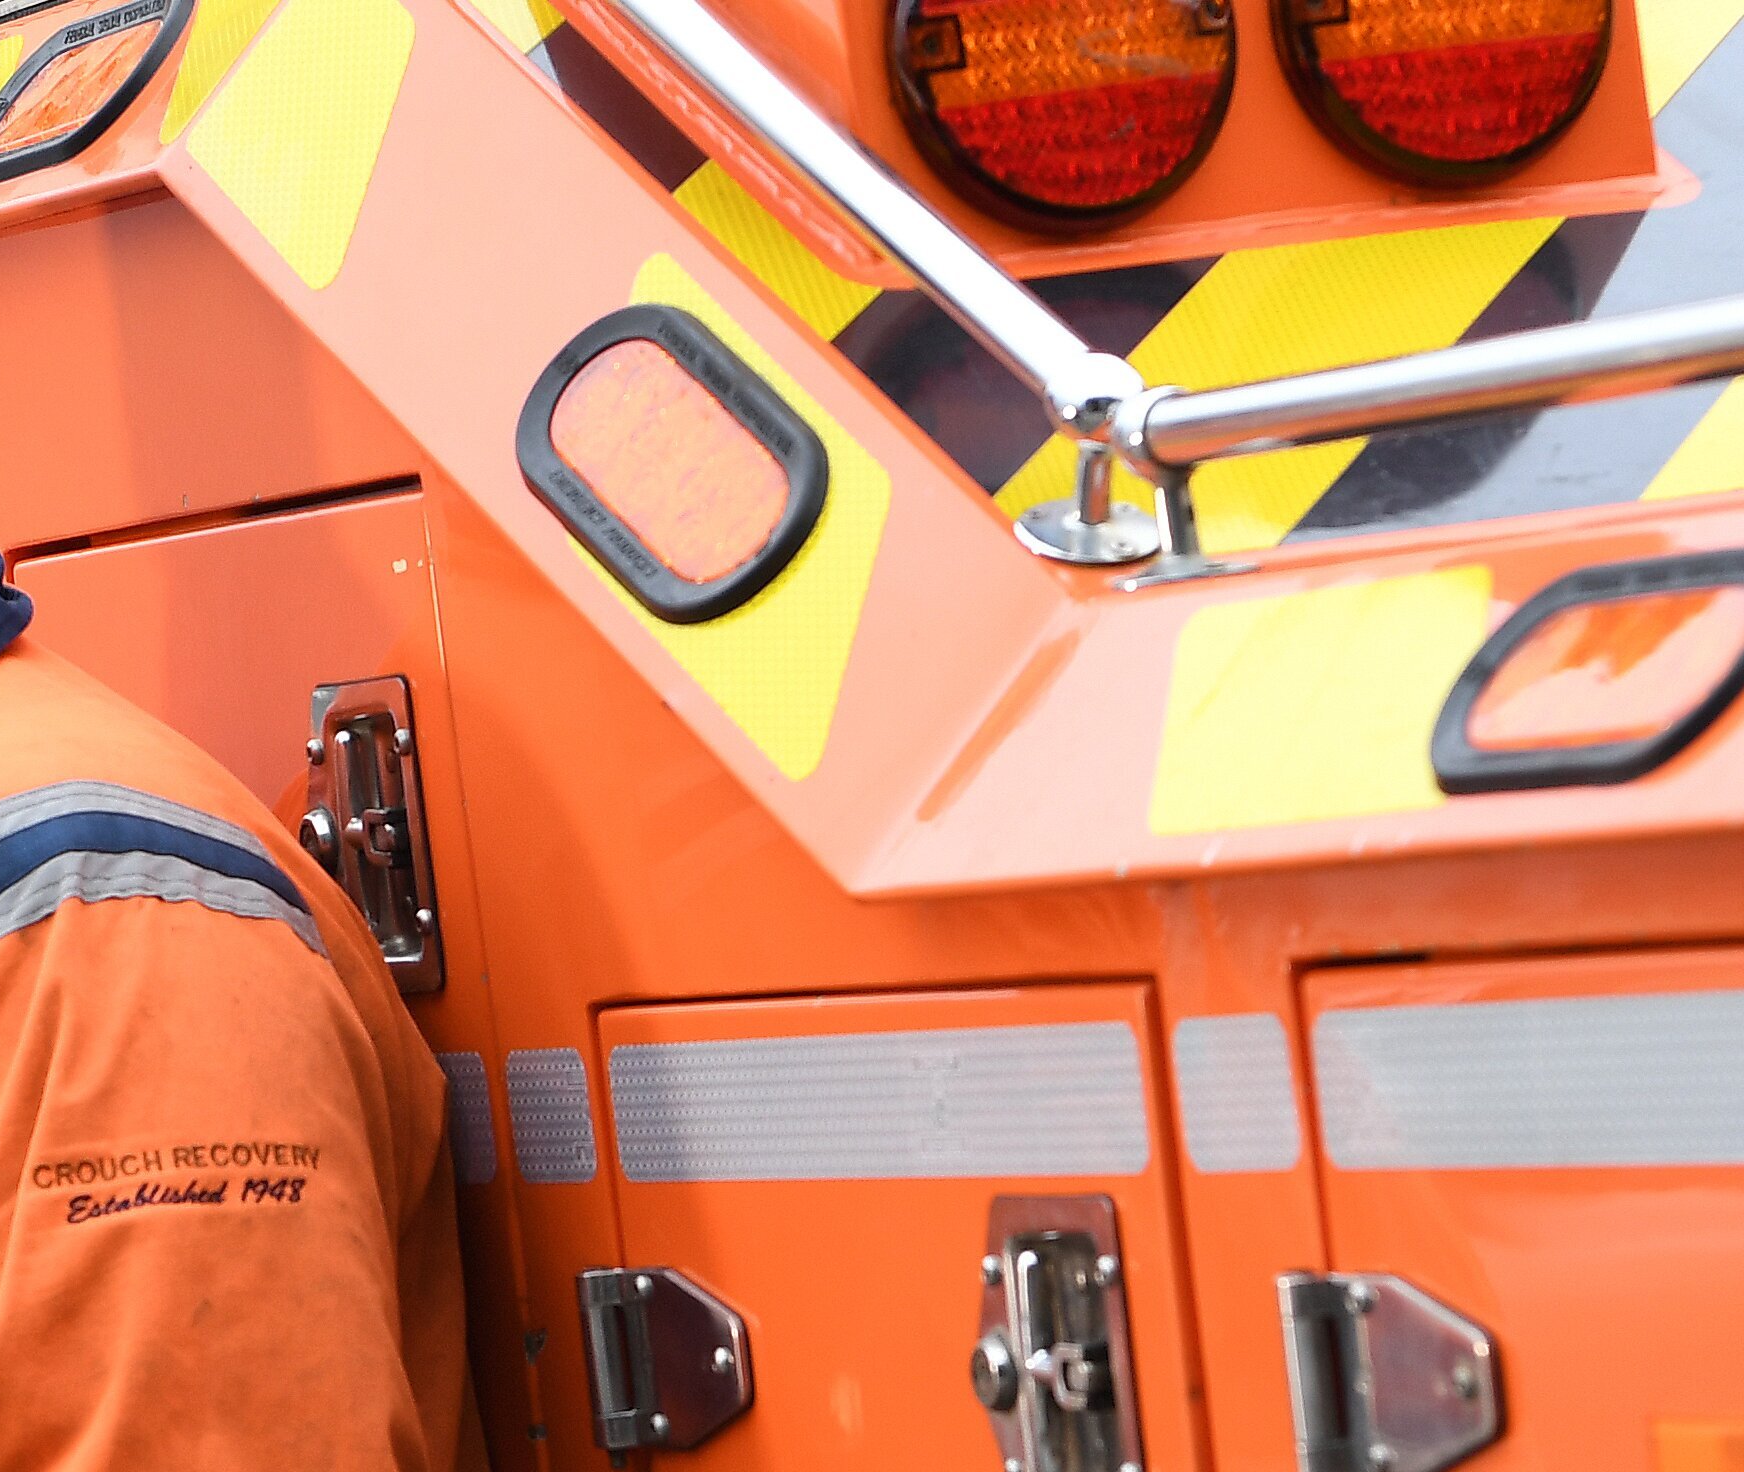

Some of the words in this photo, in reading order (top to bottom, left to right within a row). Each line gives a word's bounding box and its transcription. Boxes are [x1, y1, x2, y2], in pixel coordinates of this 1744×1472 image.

[32, 1149, 163, 1189] CROUCH
[172, 1142, 321, 1170] RECOVERY
[241, 1177, 306, 1203] 1948
